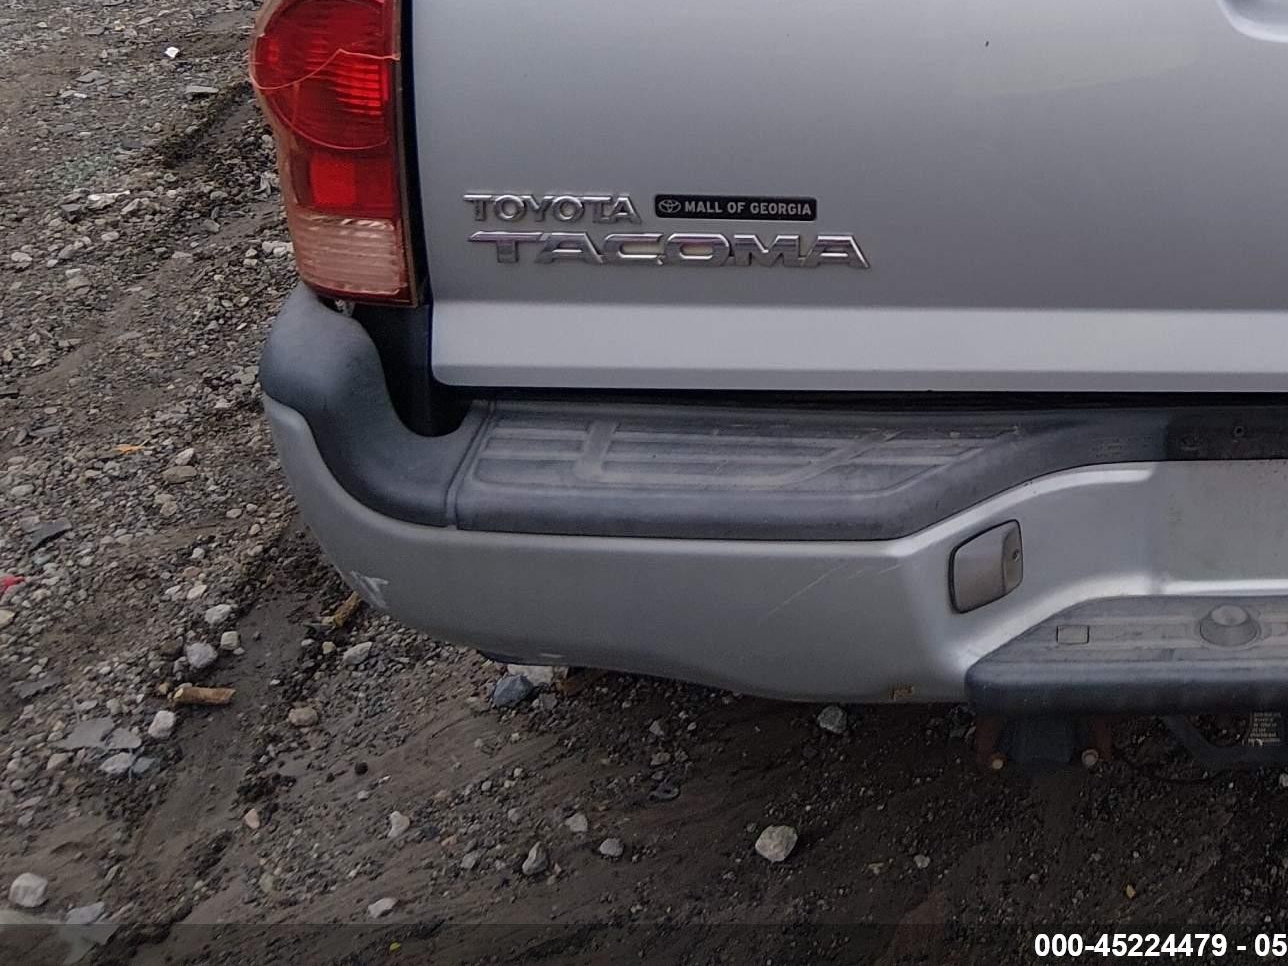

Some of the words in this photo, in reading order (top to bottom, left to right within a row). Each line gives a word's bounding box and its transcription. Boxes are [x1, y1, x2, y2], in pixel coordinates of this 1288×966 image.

[463, 193, 641, 224] TOYOTA
[684, 200, 723, 213] MALL
[727, 201, 746, 214] OF
[750, 202, 812, 215] GEORGIA
[467, 230, 870, 269] TACOMA
